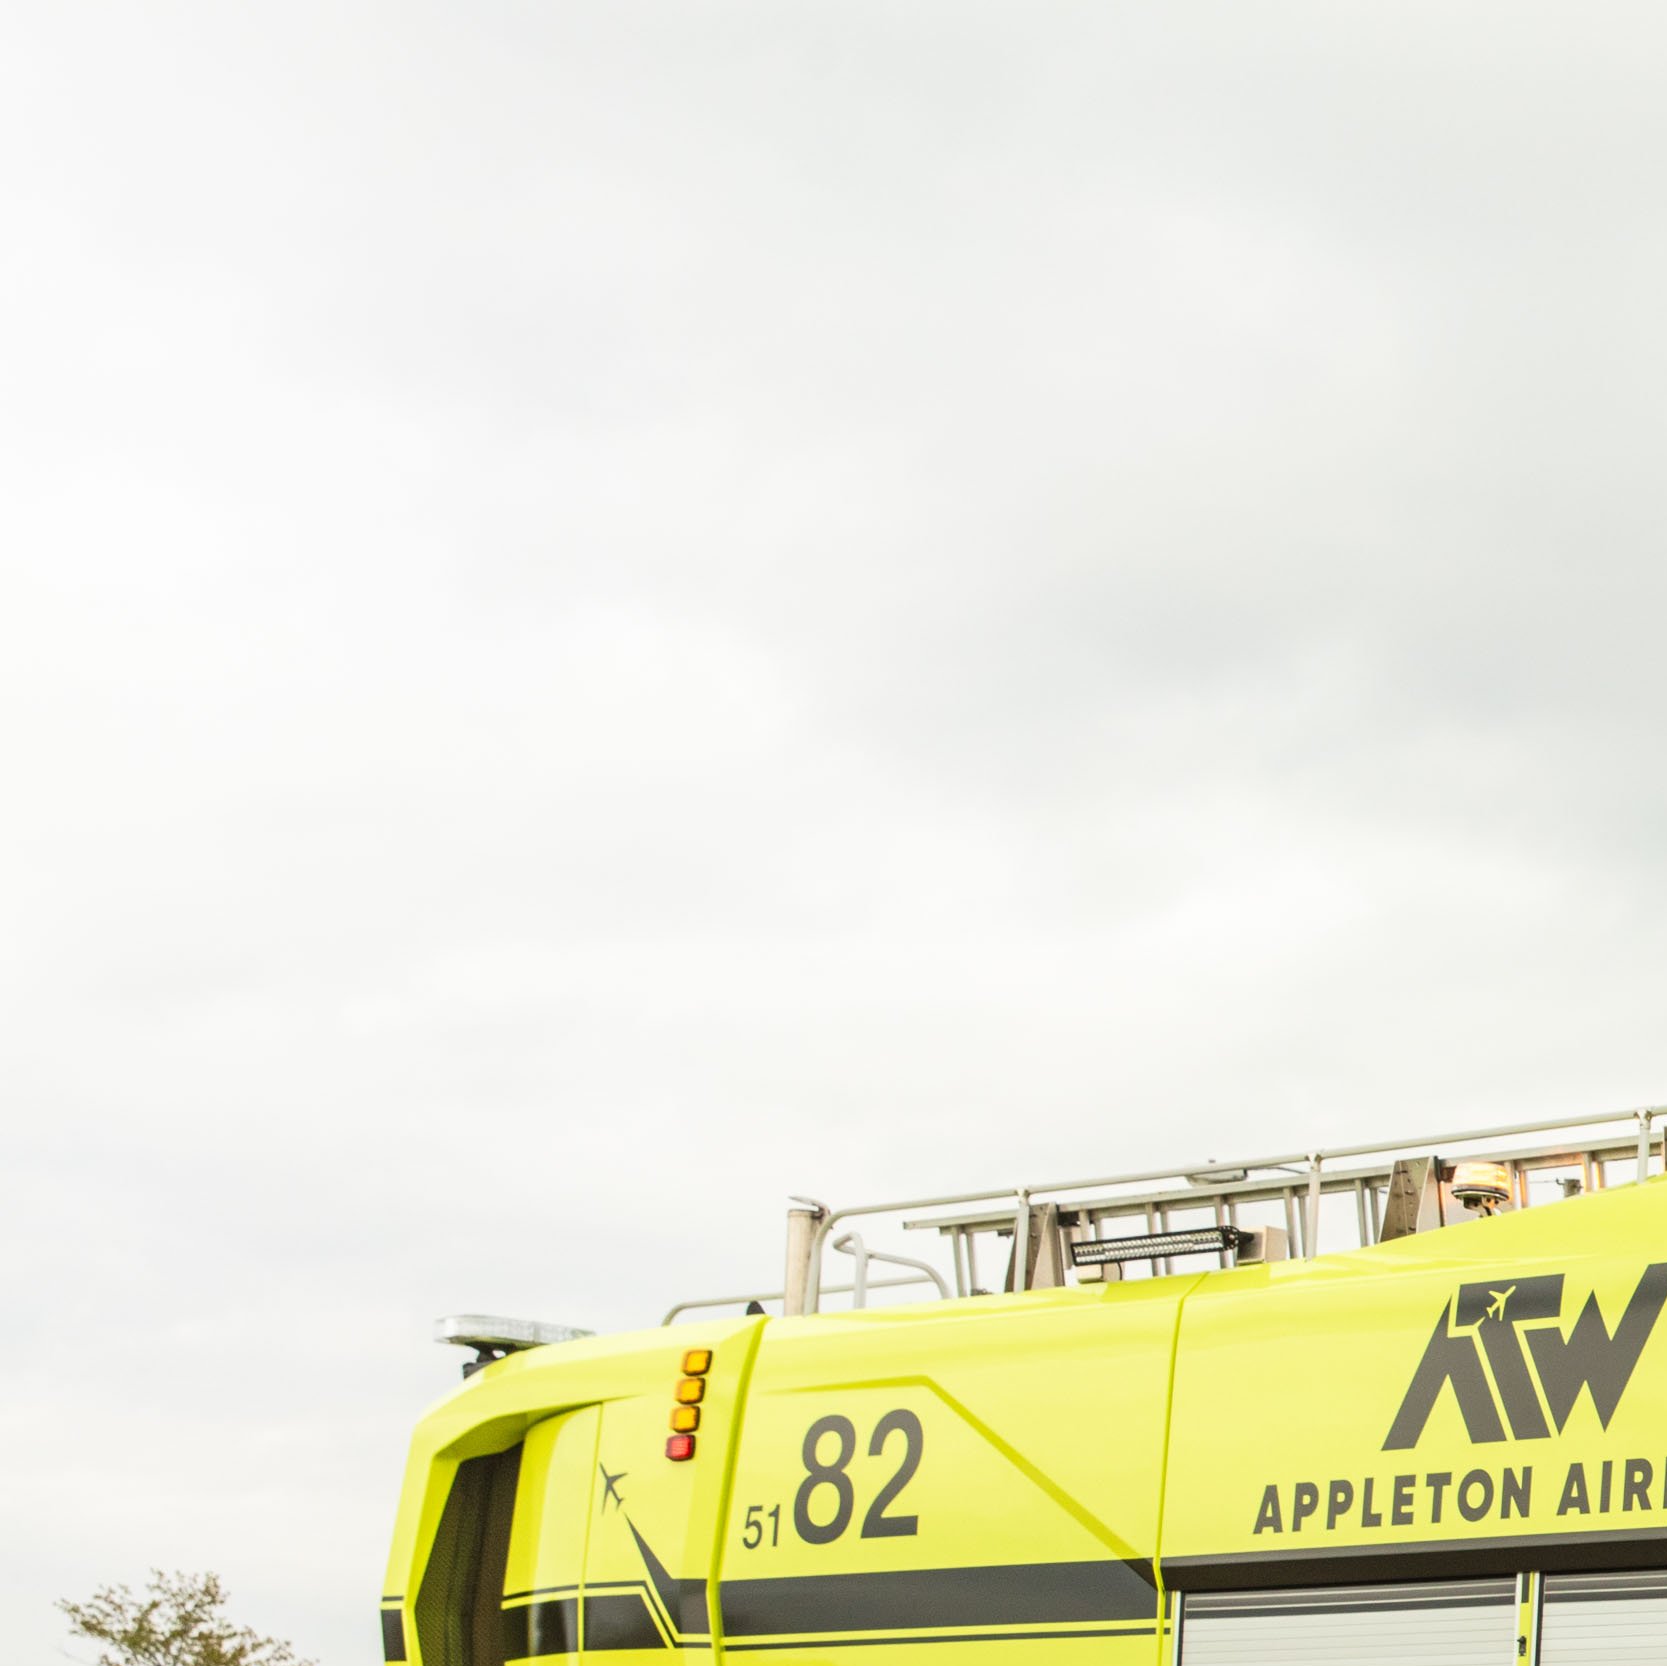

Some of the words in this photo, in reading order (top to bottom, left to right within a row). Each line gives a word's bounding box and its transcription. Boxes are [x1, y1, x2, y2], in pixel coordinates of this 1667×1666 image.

[742, 1504, 781, 1550] 51
[793, 1408, 924, 1545] 82
[1252, 1466, 1533, 1535] APPLETON
